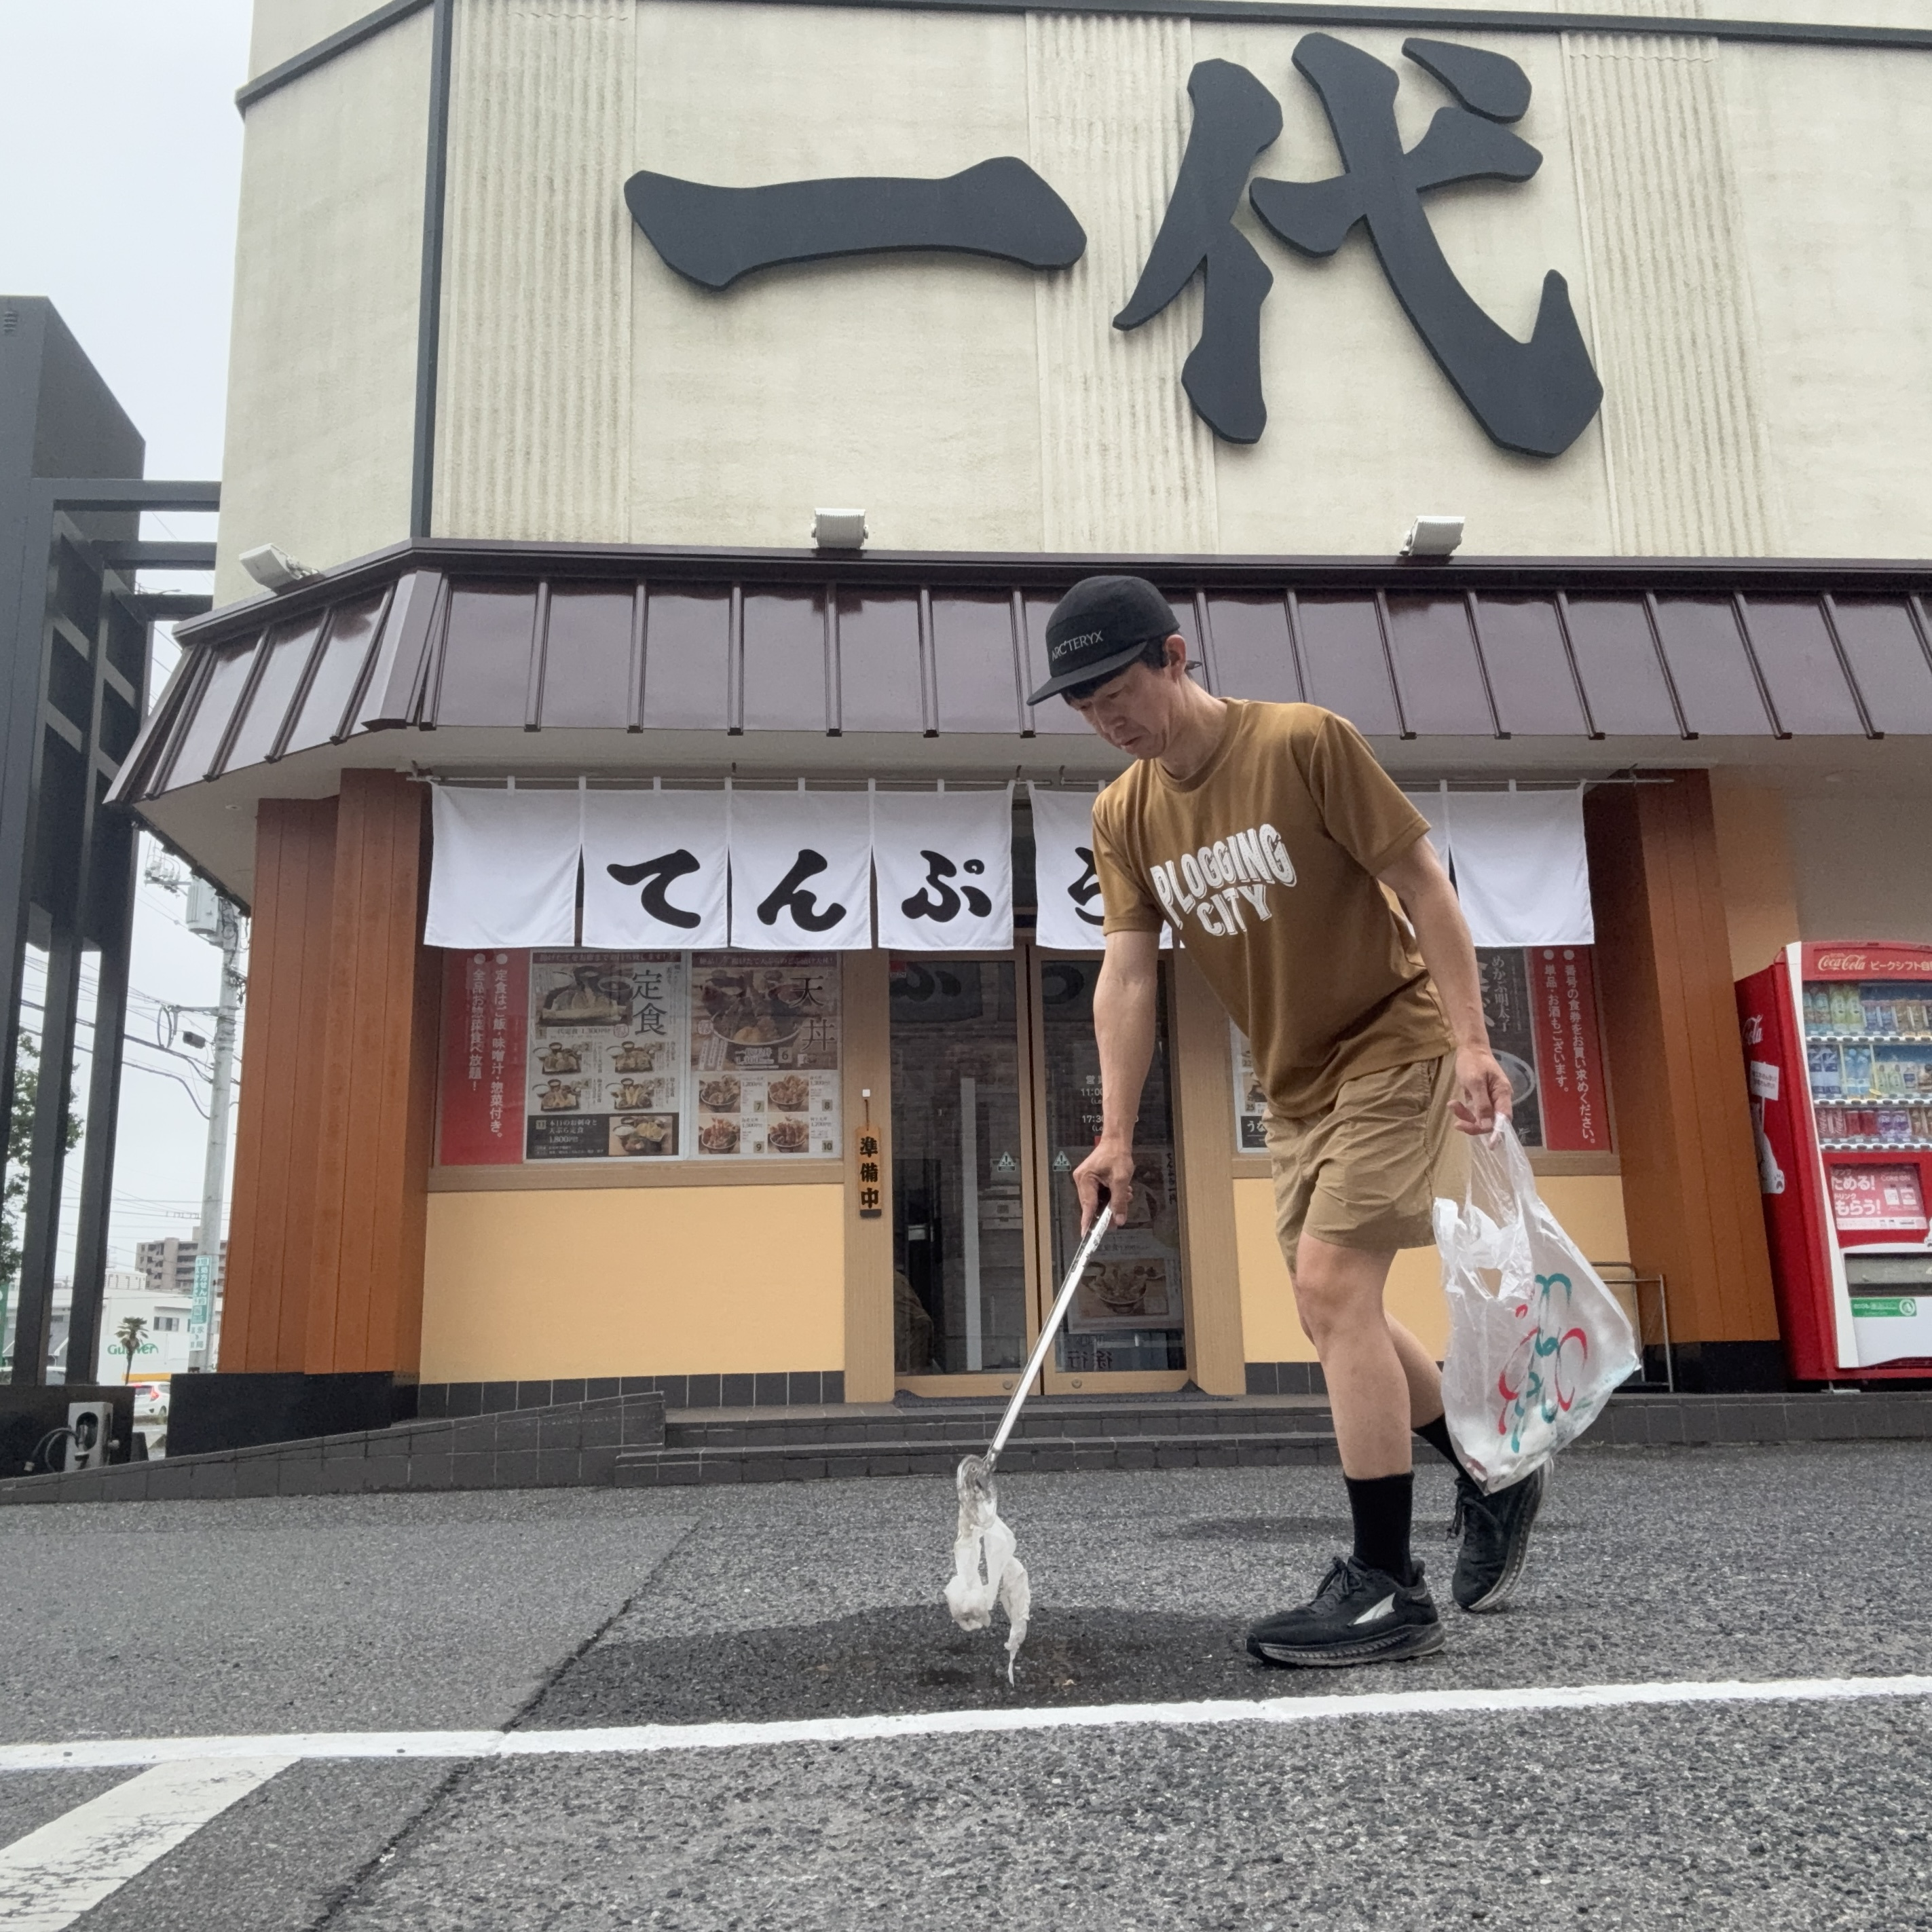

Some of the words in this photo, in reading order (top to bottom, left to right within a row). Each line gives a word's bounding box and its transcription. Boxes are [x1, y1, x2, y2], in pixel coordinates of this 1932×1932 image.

[624, 32, 1603, 458] 一代
[1150, 823, 1297, 930] PLOGGING
[1197, 884, 1272, 936] CITY
[1870, 961, 1932, 971] ピークシフト自
[631, 969, 667, 1036] 定食
[789, 976, 836, 1052] 天丼
[756, 1102, 762, 1111] 7
[823, 1102, 830, 1110] 8
[1246, 1103, 1255, 1111] 25
[756, 1143, 762, 1151] 9
[859, 1136, 879, 1208] 準備中
[1835, 1199, 1882, 1216] もらう!
